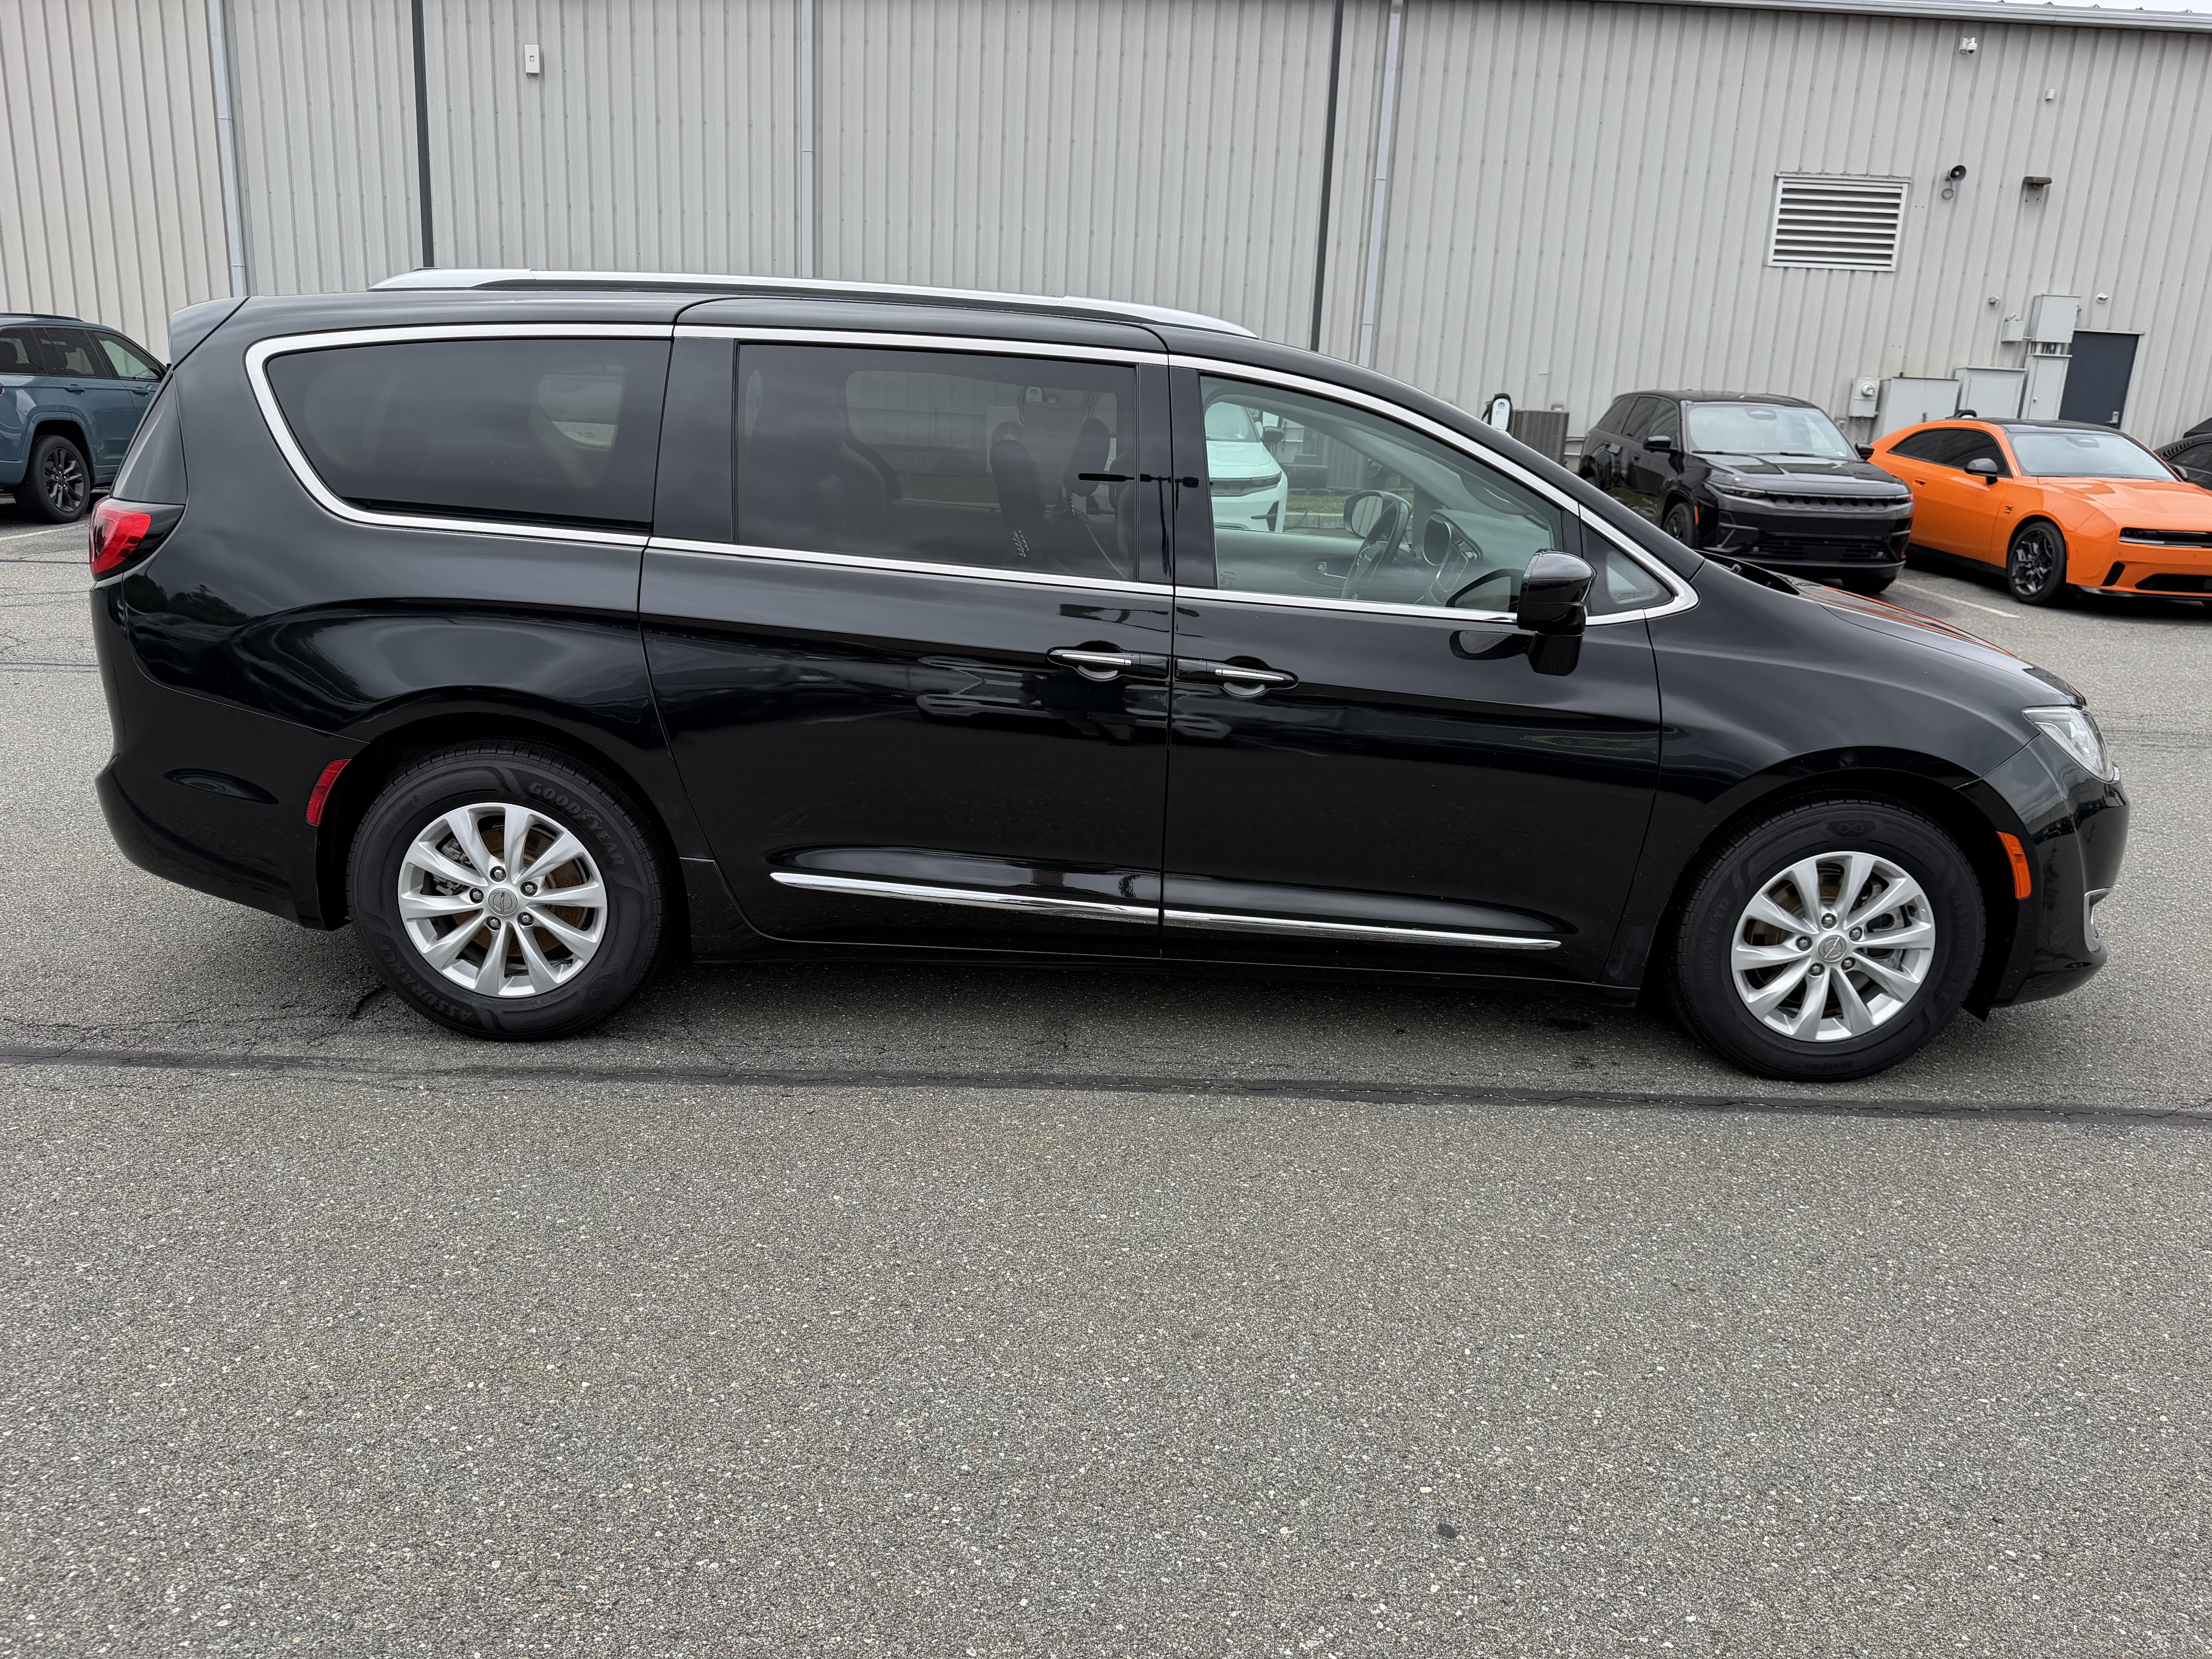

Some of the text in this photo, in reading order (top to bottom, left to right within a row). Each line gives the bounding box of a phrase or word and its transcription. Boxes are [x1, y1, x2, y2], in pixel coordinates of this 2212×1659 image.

[529, 782, 626, 866] GOODYEAR
[375, 941, 473, 1021] ASSURANCE
[1702, 897, 1731, 1006] GOODYEAR
